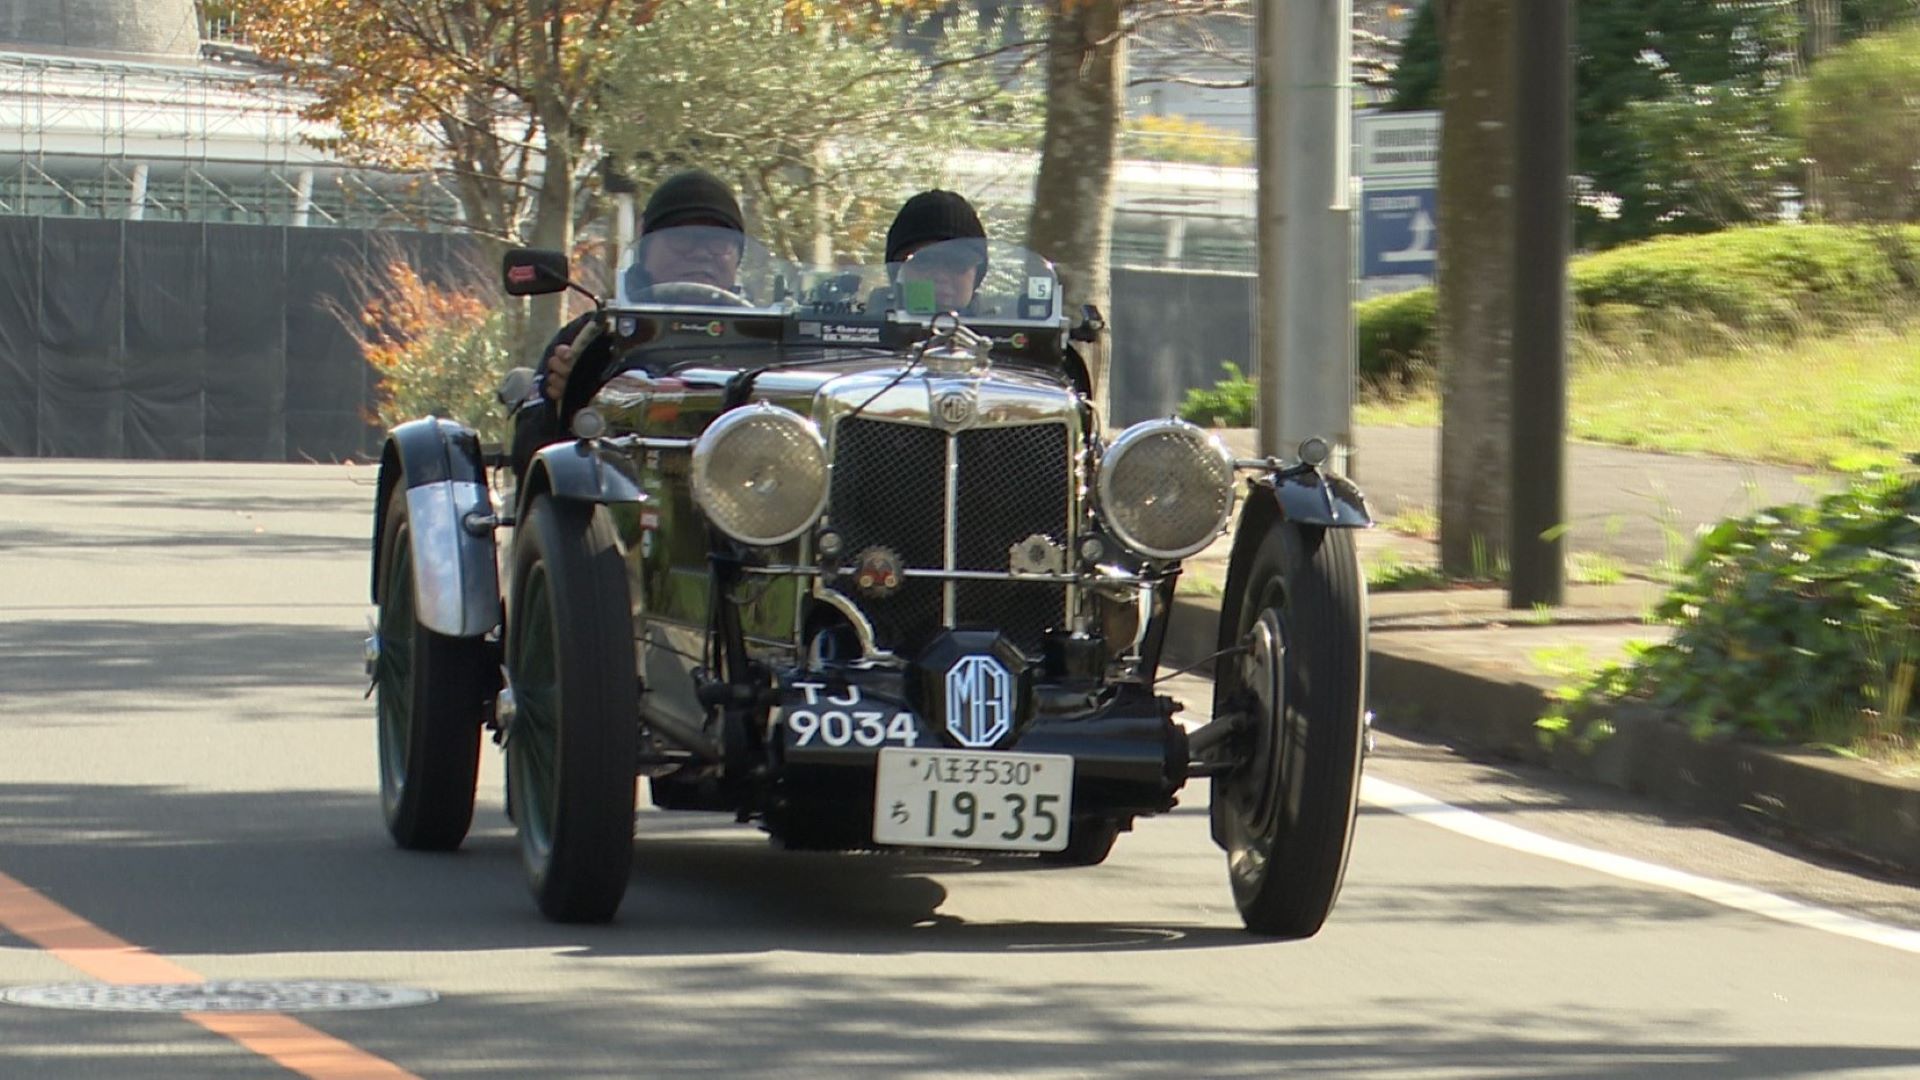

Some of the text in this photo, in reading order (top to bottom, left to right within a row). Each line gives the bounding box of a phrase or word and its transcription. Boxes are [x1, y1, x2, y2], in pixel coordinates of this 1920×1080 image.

[791, 681, 862, 706] TJ
[948, 656, 1008, 747] MG
[788, 709, 919, 748] 9034
[923, 757, 1031, 786] 八王子530
[890, 789, 1060, 842] ち 19-35
